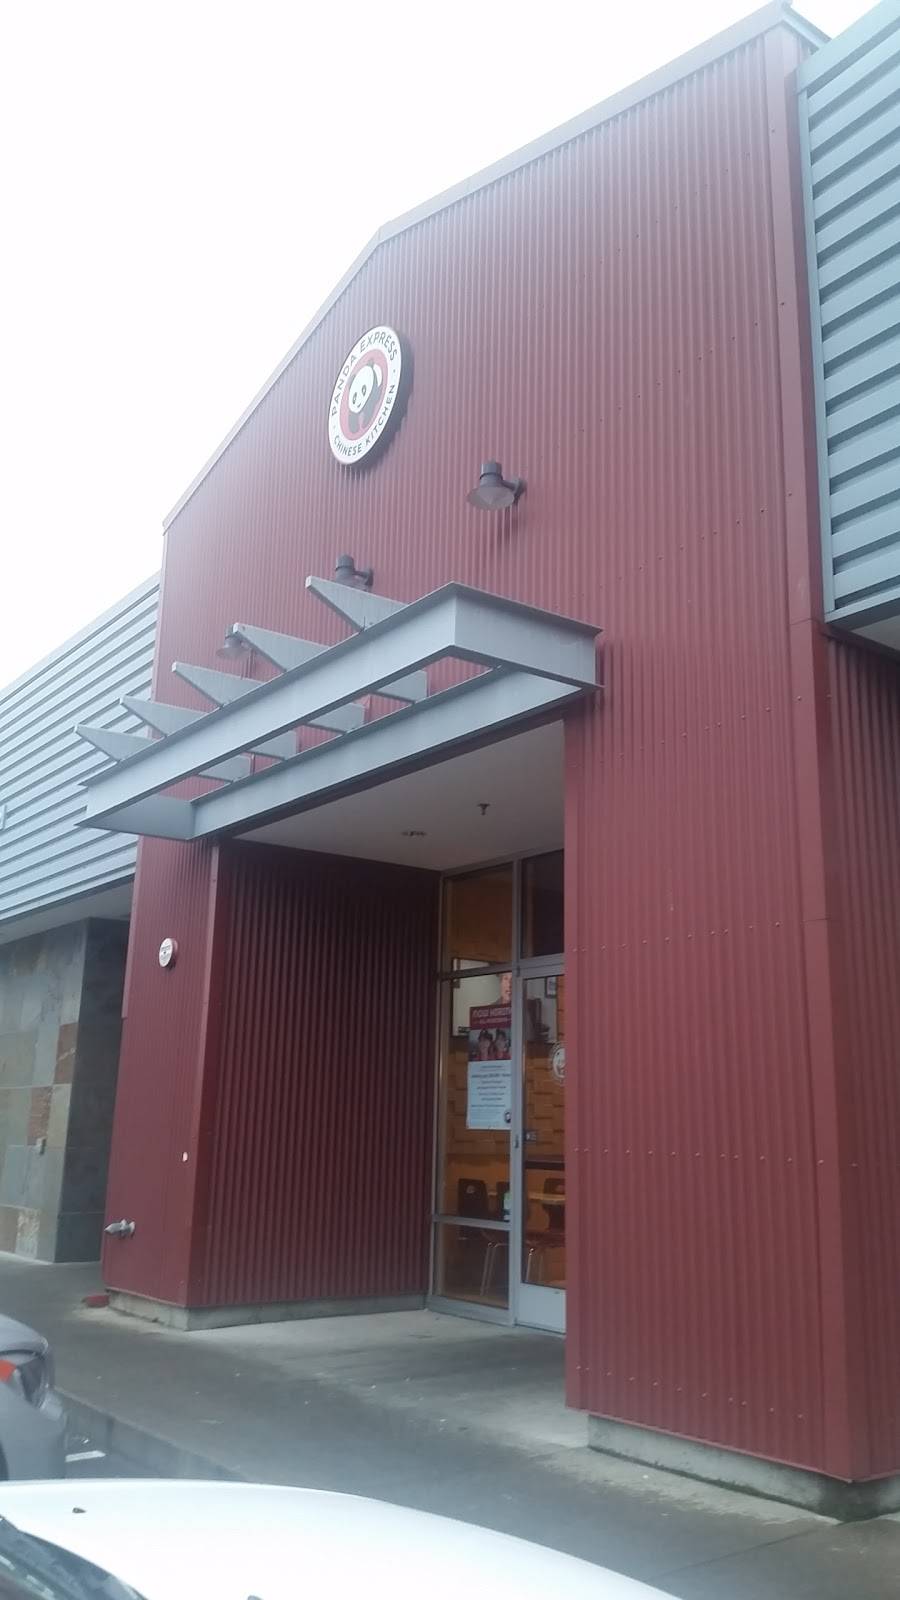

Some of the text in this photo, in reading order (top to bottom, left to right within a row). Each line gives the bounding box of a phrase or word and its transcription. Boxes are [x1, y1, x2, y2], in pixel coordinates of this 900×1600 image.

[331, 331, 398, 416] PANDA EXPRESS
[333, 384, 396, 457] CHINESE KITCHEN
